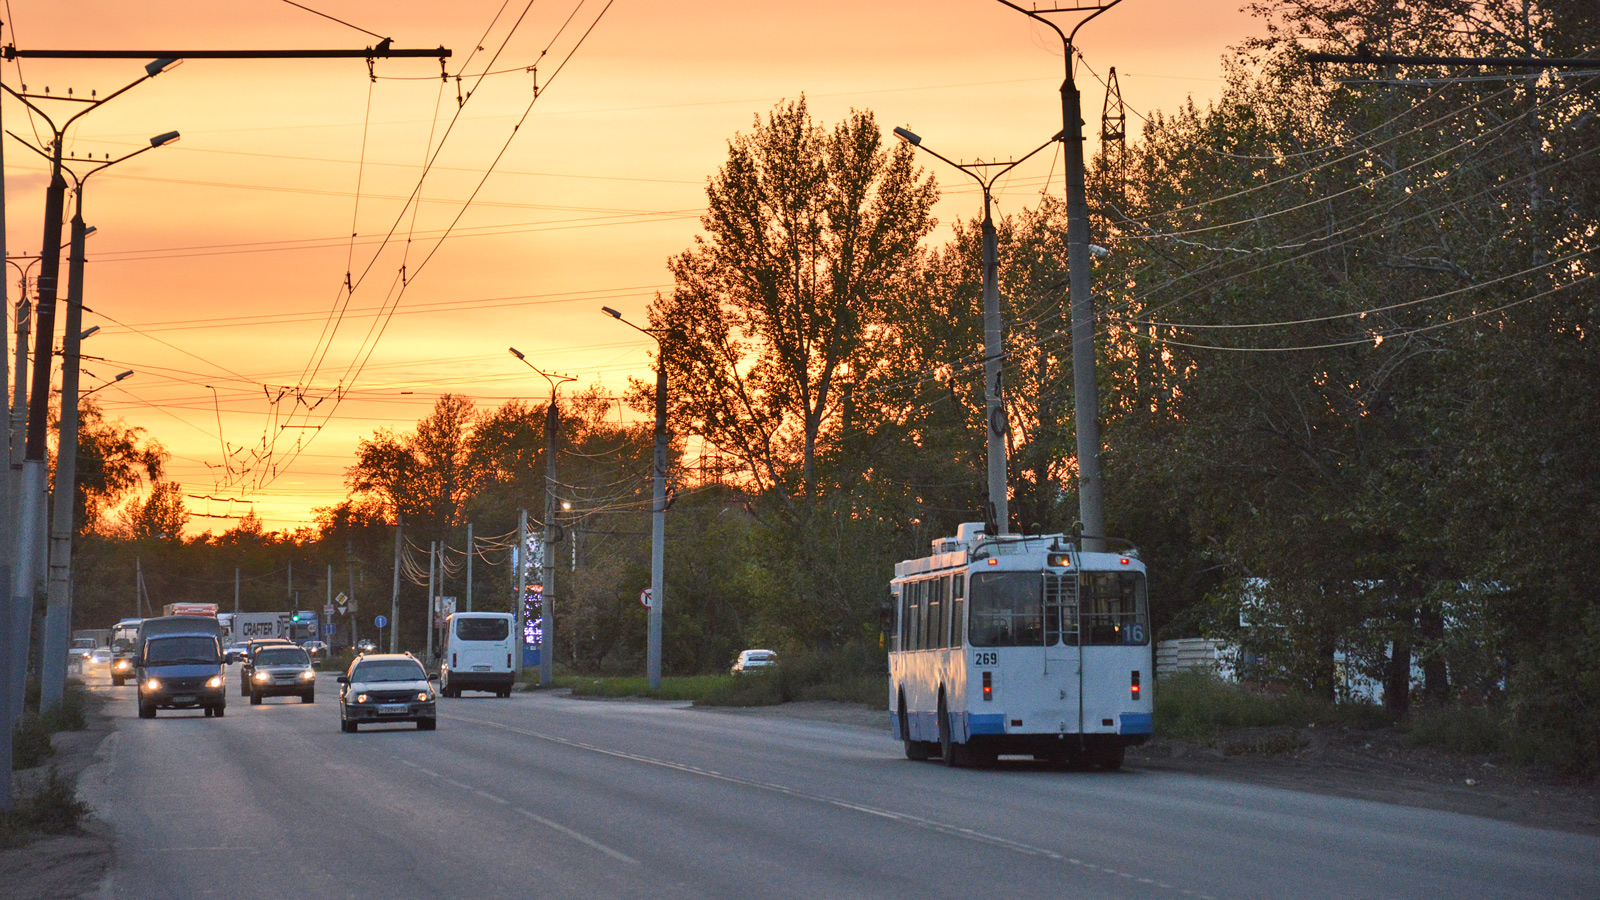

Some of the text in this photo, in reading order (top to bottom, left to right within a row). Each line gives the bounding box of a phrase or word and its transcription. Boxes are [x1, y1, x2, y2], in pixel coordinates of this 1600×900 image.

[243, 622, 273, 636] CRAFTER
[1123, 625, 1144, 642] 16
[975, 652, 998, 666] 269
